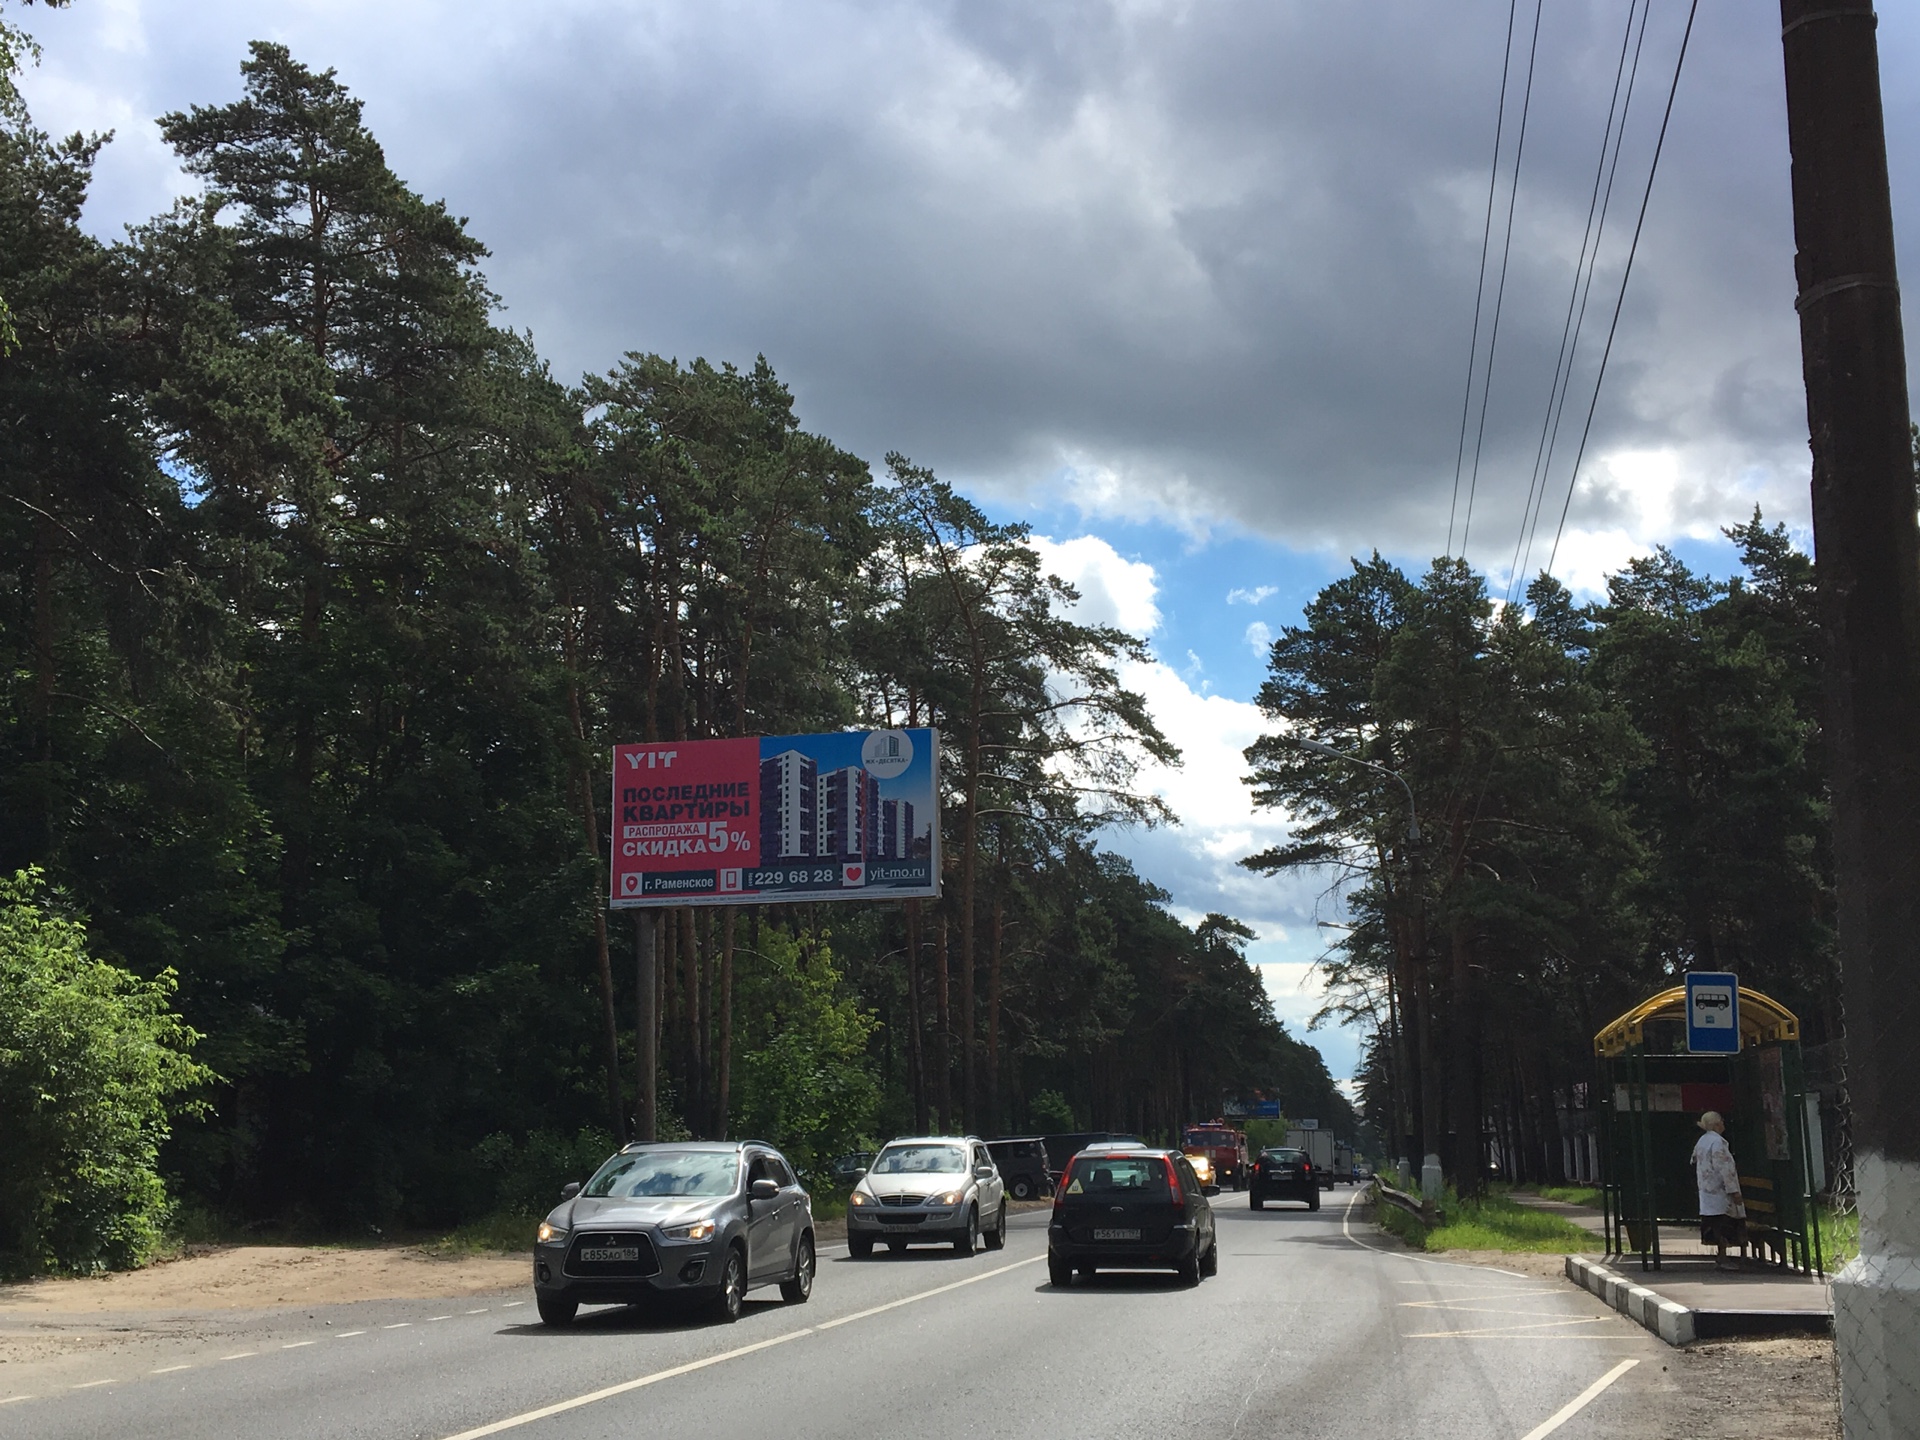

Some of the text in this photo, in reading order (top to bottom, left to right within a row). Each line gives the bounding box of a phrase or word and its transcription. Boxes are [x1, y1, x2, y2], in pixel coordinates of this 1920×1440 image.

[623, 751, 678, 770] YIT
[623, 782, 750, 803] ПОСЛЕДНИЕ
[623, 800, 750, 823] КВАРТИРЫ
[622, 821, 751, 858] СКИДКА 5%
[628, 824, 700, 837] РАСПРОДАЖА
[754, 869, 834, 886] 229 68 28
[870, 867, 925, 881] yit-mo.ru
[644, 877, 714, 890] г. Раменское
